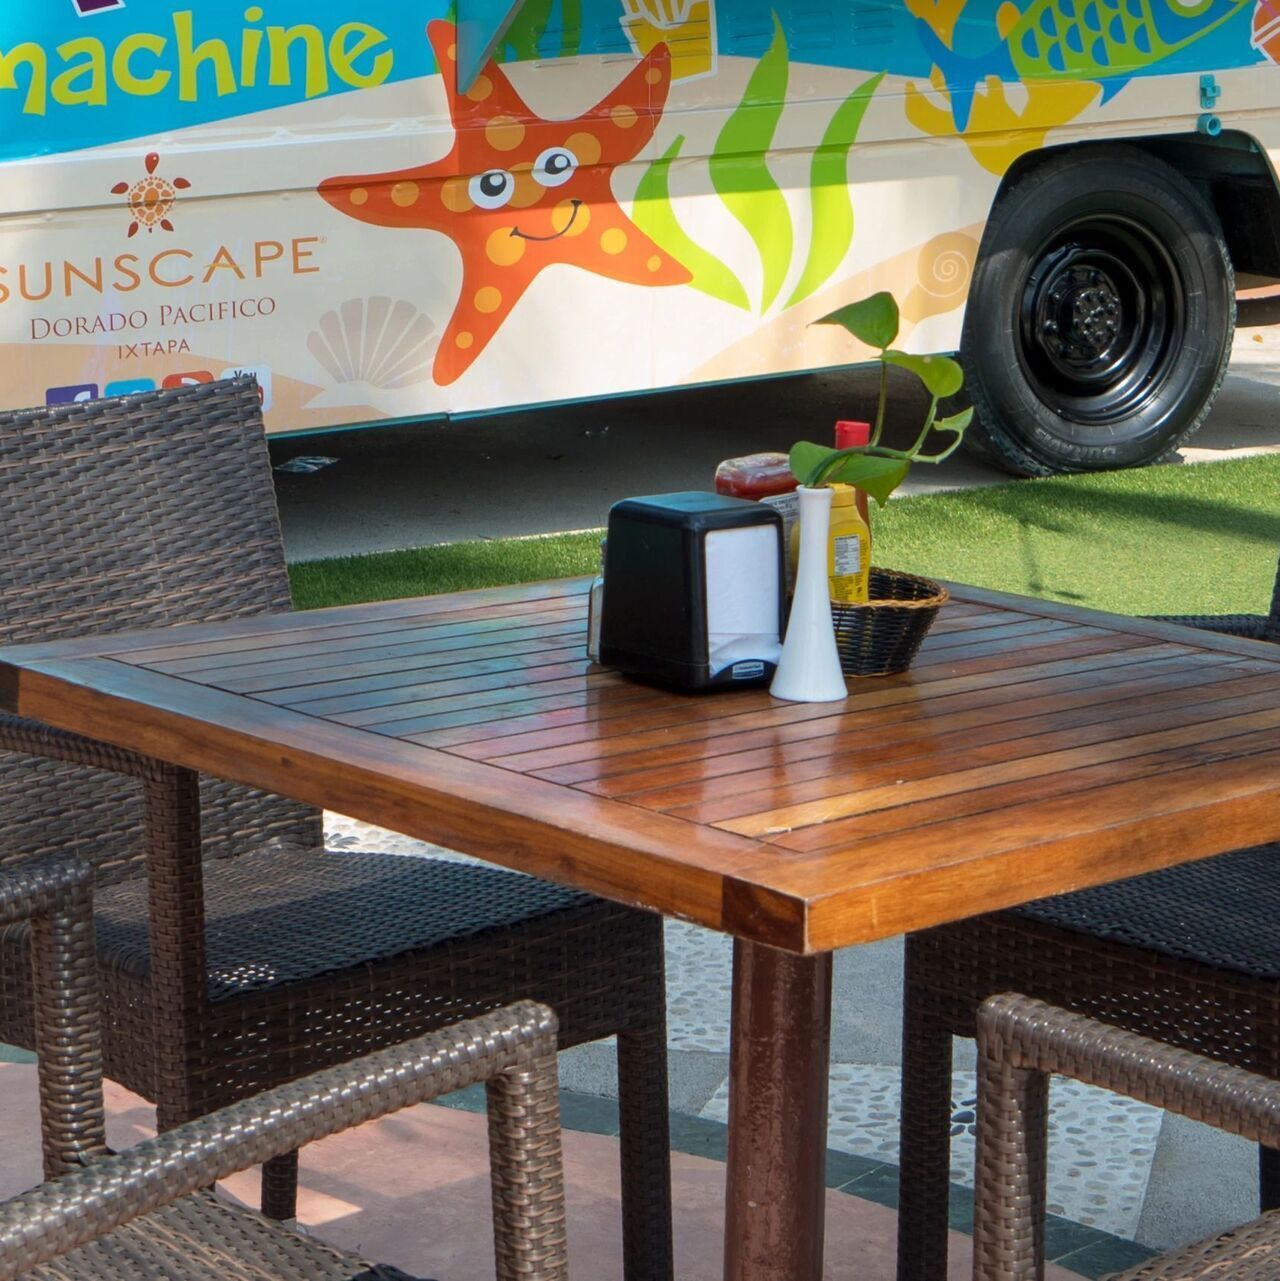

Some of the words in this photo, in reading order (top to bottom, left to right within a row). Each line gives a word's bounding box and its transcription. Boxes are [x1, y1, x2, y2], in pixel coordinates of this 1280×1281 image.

[30, 310, 149, 340] DORADO
[160, 296, 277, 326] PACIFICO
[118, 338, 192, 361] IXTAPA
